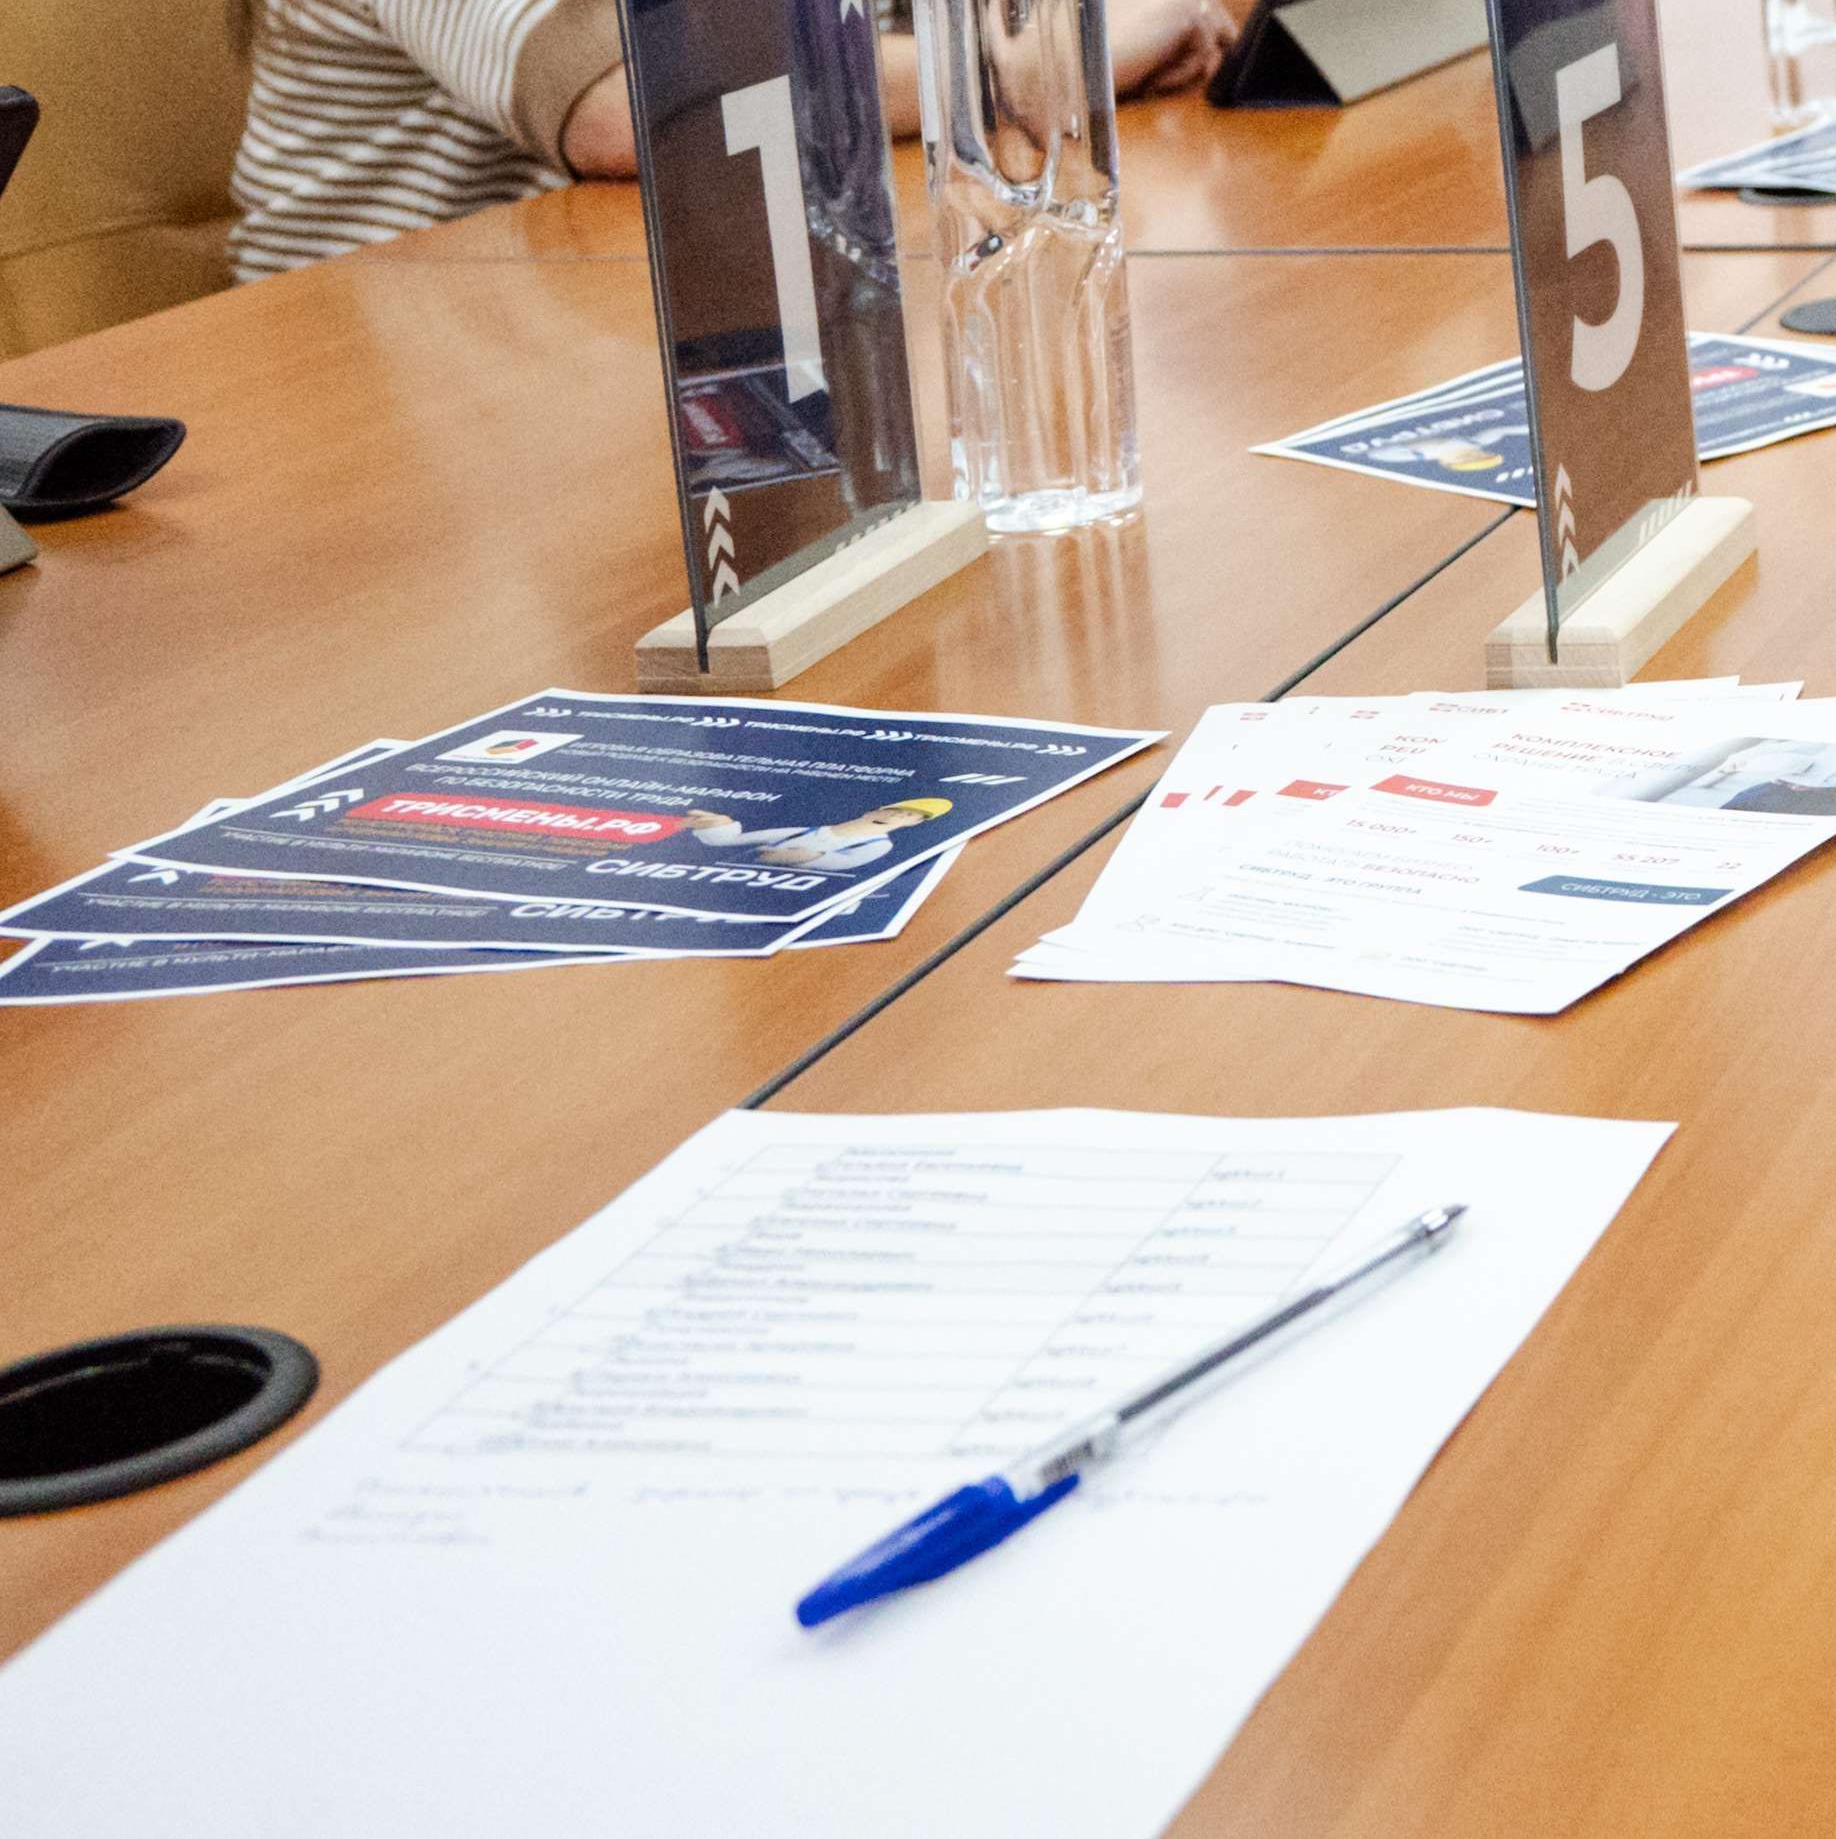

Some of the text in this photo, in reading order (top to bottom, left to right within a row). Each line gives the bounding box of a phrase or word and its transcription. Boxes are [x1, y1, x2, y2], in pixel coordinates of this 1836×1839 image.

[1556, 41, 1645, 393] 5
[720, 73, 832, 405] 1
[1491, 742, 1605, 763] РЕШЕНИЕ
[1511, 733, 1684, 760] КОМПЛЕКСНОЕ
[404, 762, 783, 803] ВСЕРОССИЙСКИЙ ОНЛАЙН-МАРАФОН
[463, 777, 629, 800] БЕЗОПАСНОСТИ
[627, 792, 695, 807] ТРУДА
[1404, 783, 1482, 802] КТО МЫ
[380, 799, 663, 836] ТРИСМЕНЫ.РФ
[585, 858, 829, 892] СИБТРУД
[1360, 862, 1481, 885] БЕЗОПАСНО
[1558, 881, 1651, 900] СИБТРУД
[1659, 891, 1703, 902] ЭТО
